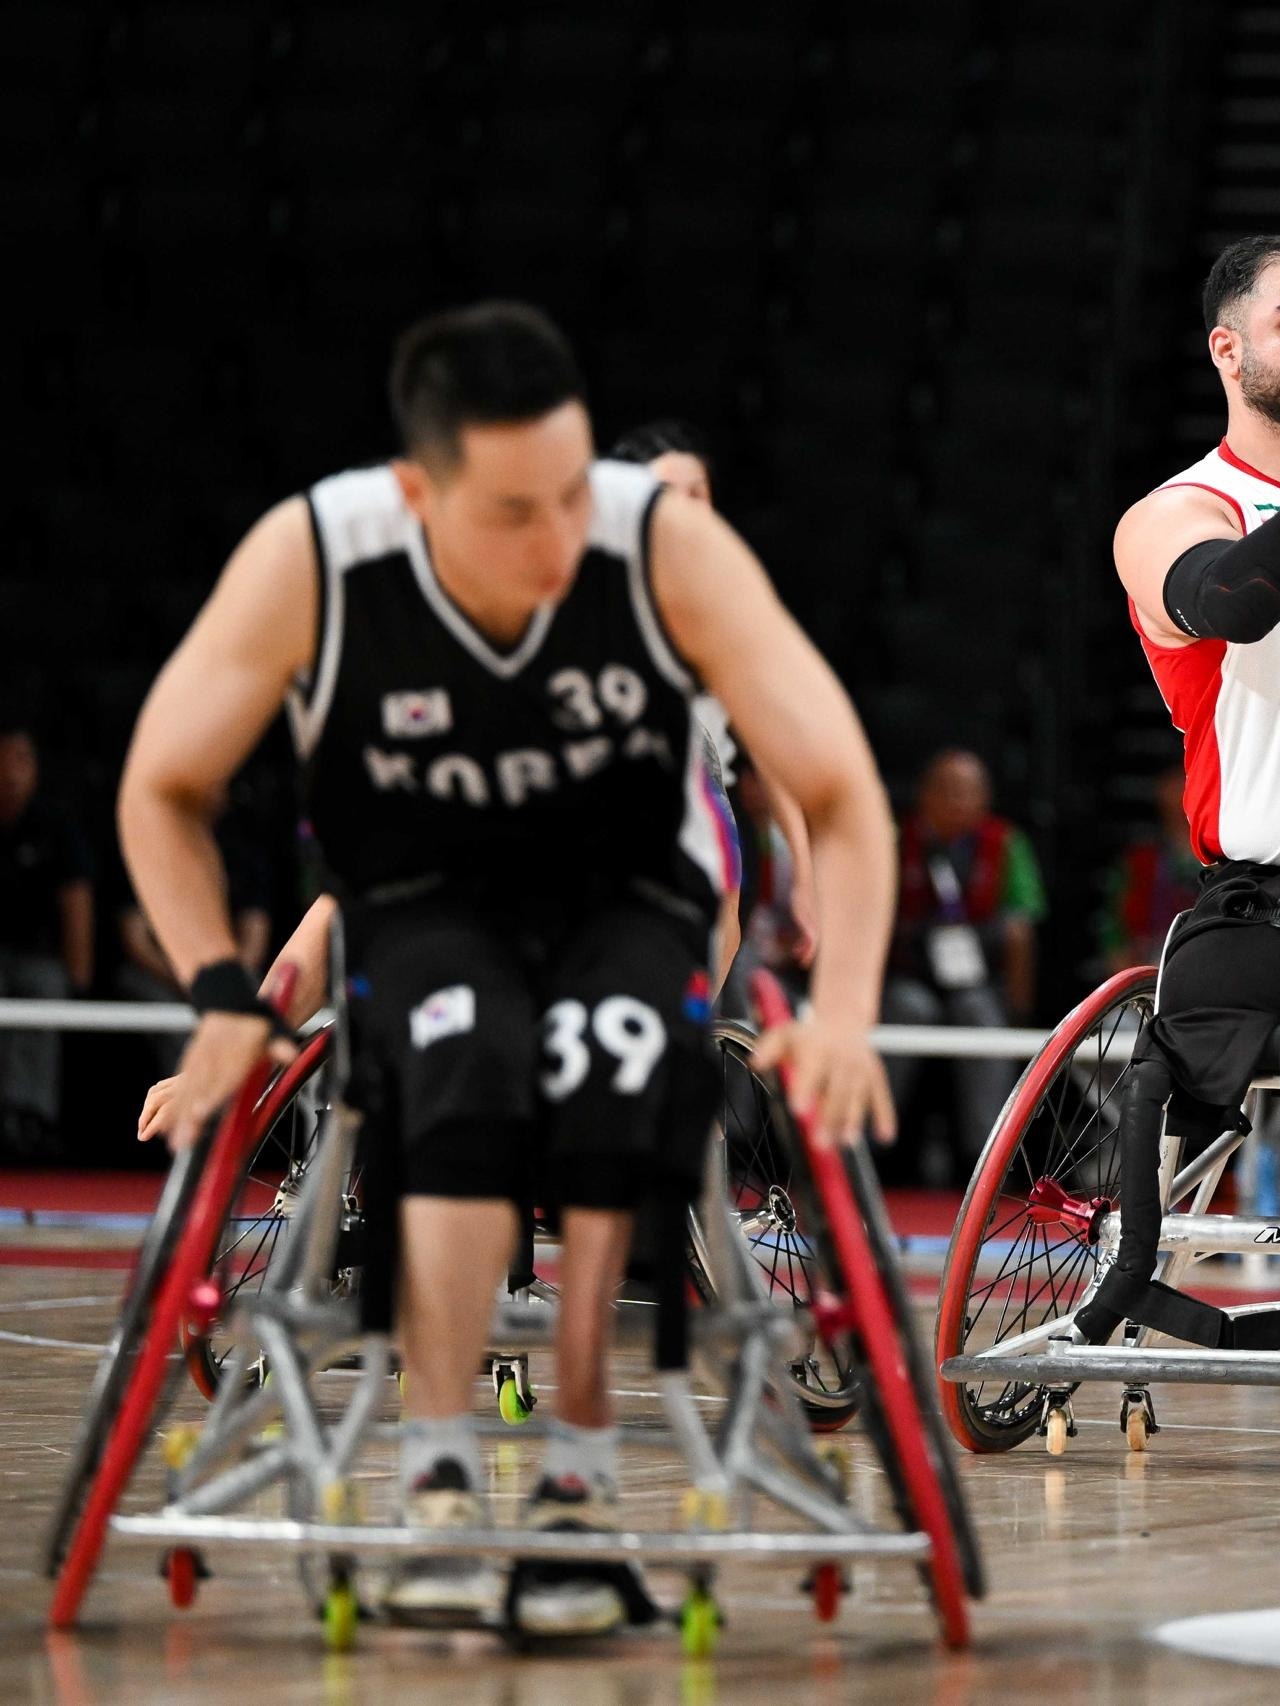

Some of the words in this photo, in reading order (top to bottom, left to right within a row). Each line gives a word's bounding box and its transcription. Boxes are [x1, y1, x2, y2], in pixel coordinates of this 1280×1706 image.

[548, 663, 647, 728] 39
[364, 727, 675, 808] KOR
[541, 994, 667, 1100] 39
